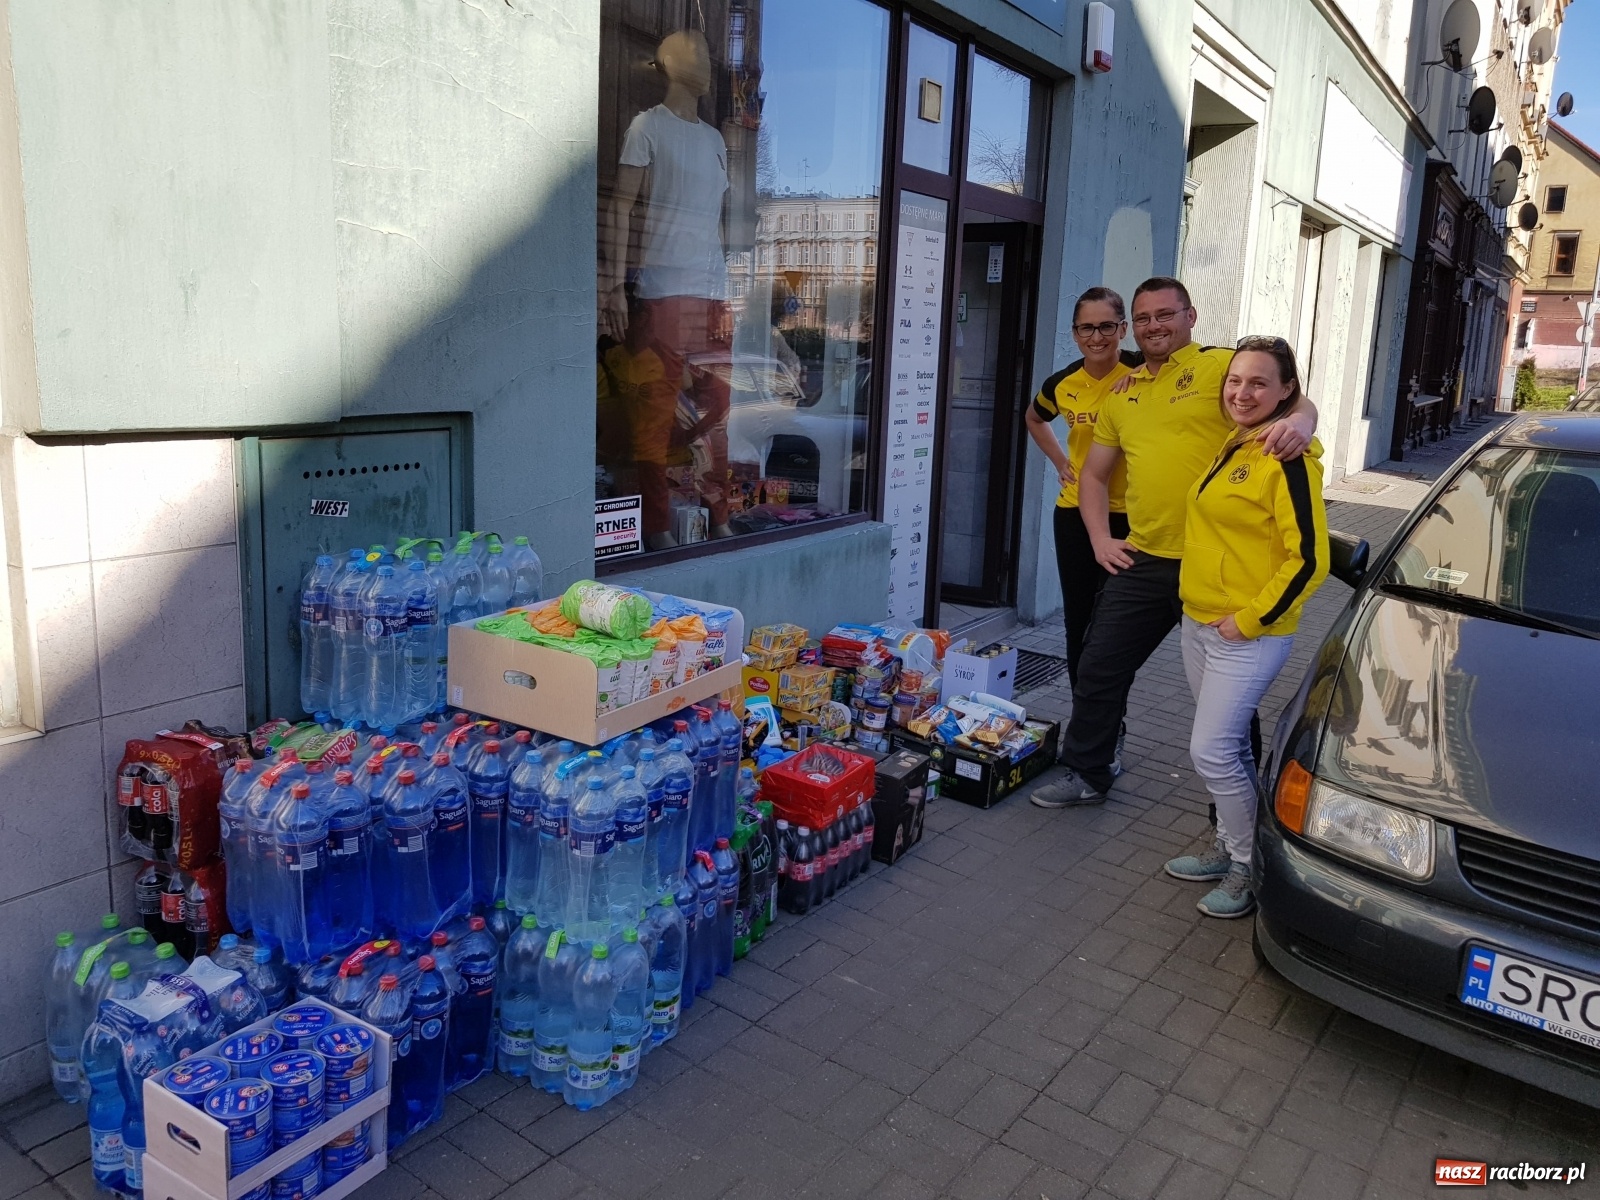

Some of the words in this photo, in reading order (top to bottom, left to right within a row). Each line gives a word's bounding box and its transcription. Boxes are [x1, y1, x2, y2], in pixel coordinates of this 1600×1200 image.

[901, 204, 928, 219] DOSTĘPNE
[929, 209, 945, 222] MARKI
[900, 319, 911, 328] FILA
[916, 370, 934, 379] Barbour
[1077, 412, 1098, 423] EV
[312, 500, 346, 516] WEST
[596, 517, 636, 534] RTNER
[613, 532, 636, 540] security
[407, 608, 436, 619] Saguaro
[954, 669, 975, 680] SYROP
[1008, 766, 1023, 788] 3L
[152, 790, 161, 812] cola
[476, 798, 504, 807] Saguaro
[440, 806, 467, 820] Saguaro
[347, 948, 372, 965] Saguaro
[1468, 976, 1486, 991] PL
[1464, 995, 1494, 1011] AUTO
[1496, 1006, 1541, 1027] SERWIS
[1547, 1022, 1600, 1047] WŁADARZ
